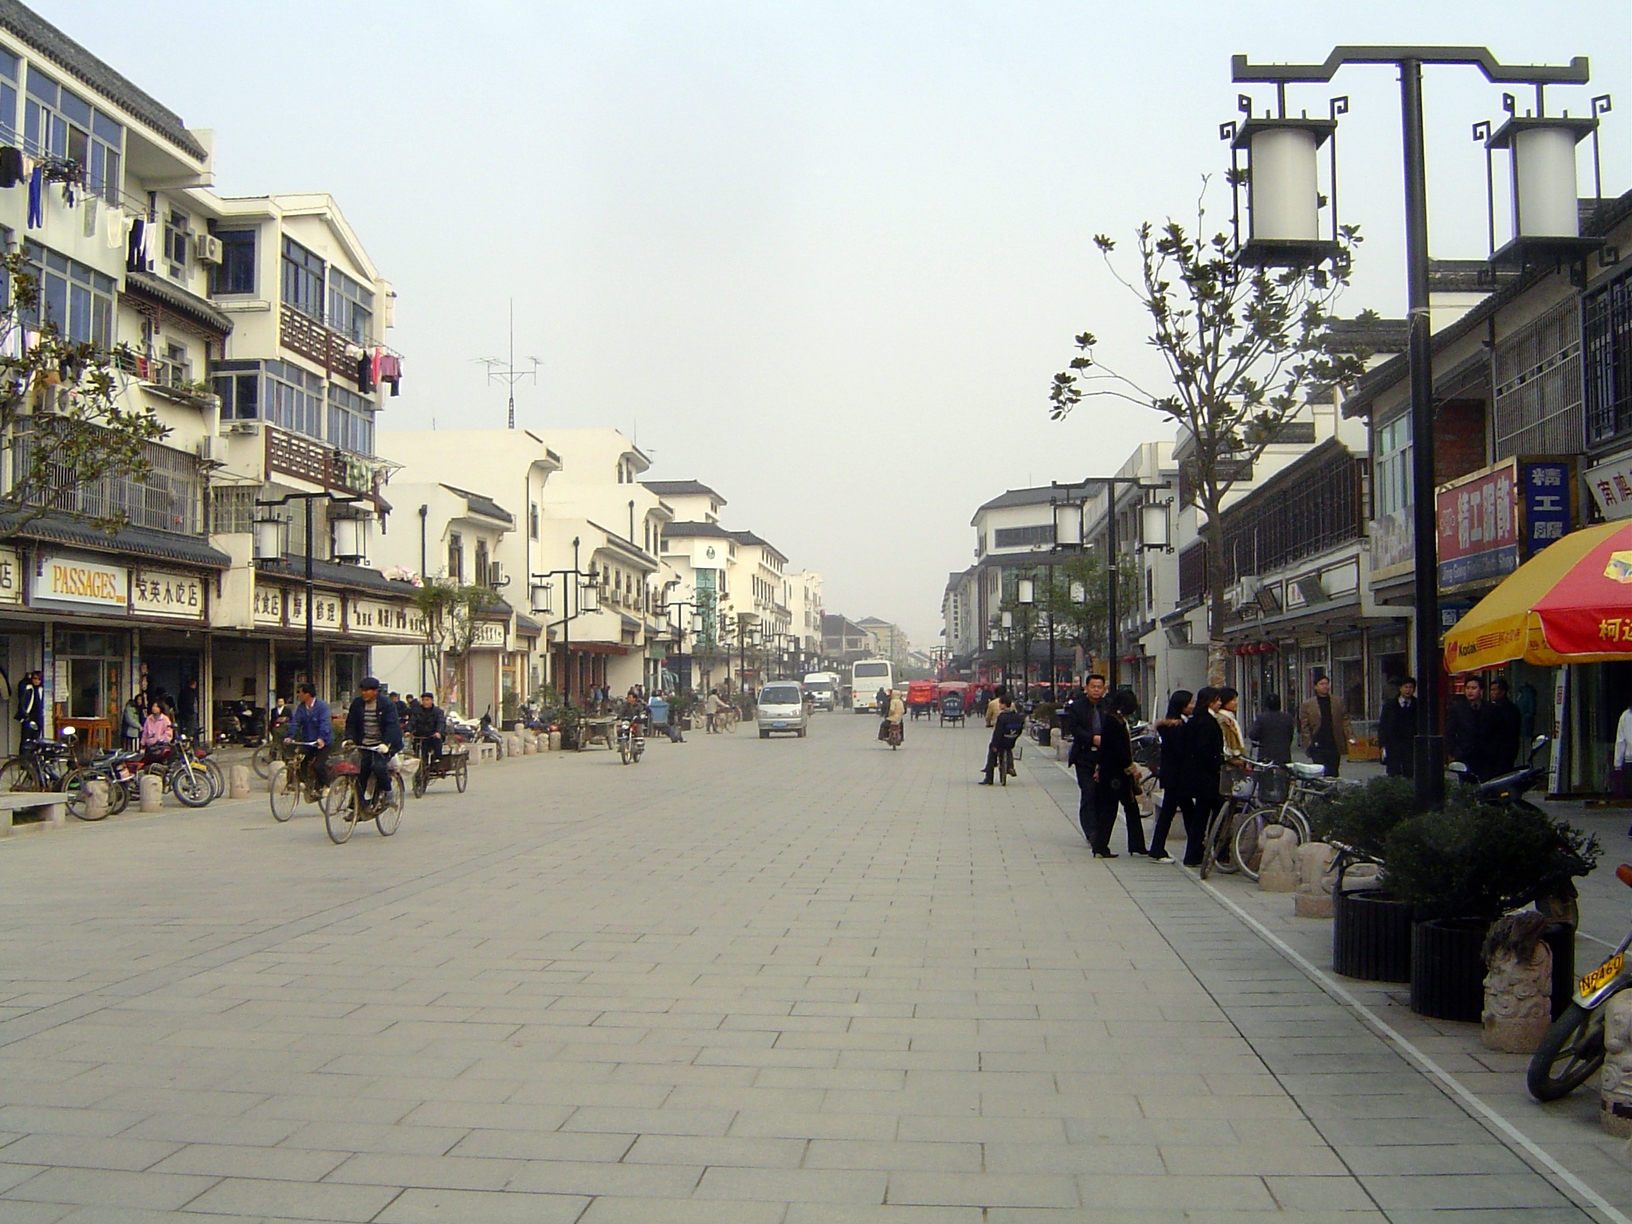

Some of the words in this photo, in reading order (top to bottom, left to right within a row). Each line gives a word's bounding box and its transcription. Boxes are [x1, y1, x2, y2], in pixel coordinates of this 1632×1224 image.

[1532, 468, 1562, 554] 精工服
[53, 564, 116, 599] PASSAGES
[1458, 641, 1477, 657] Kodak
